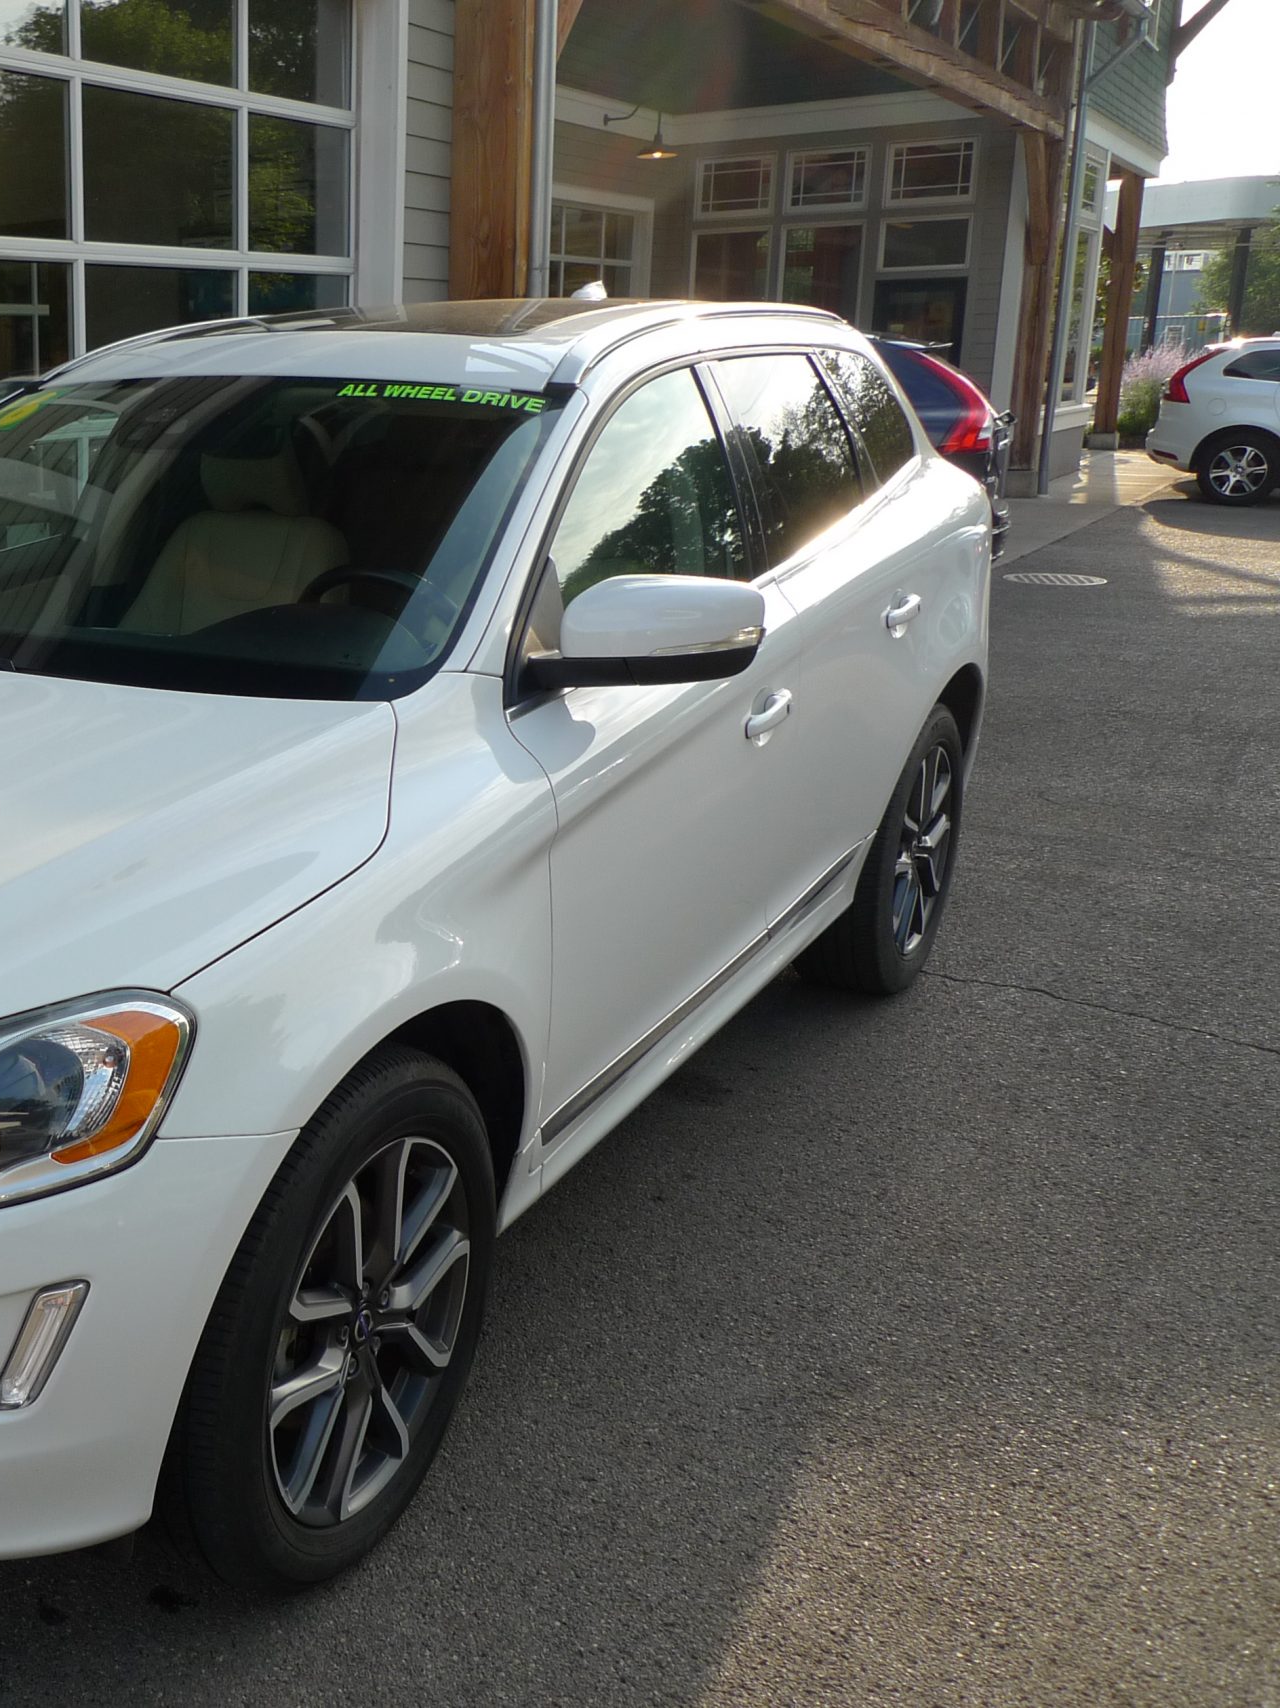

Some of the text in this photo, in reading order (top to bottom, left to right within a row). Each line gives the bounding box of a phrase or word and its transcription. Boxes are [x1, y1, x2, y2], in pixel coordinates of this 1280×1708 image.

[336, 383, 546, 414] ALL WHEEL DRIVE
